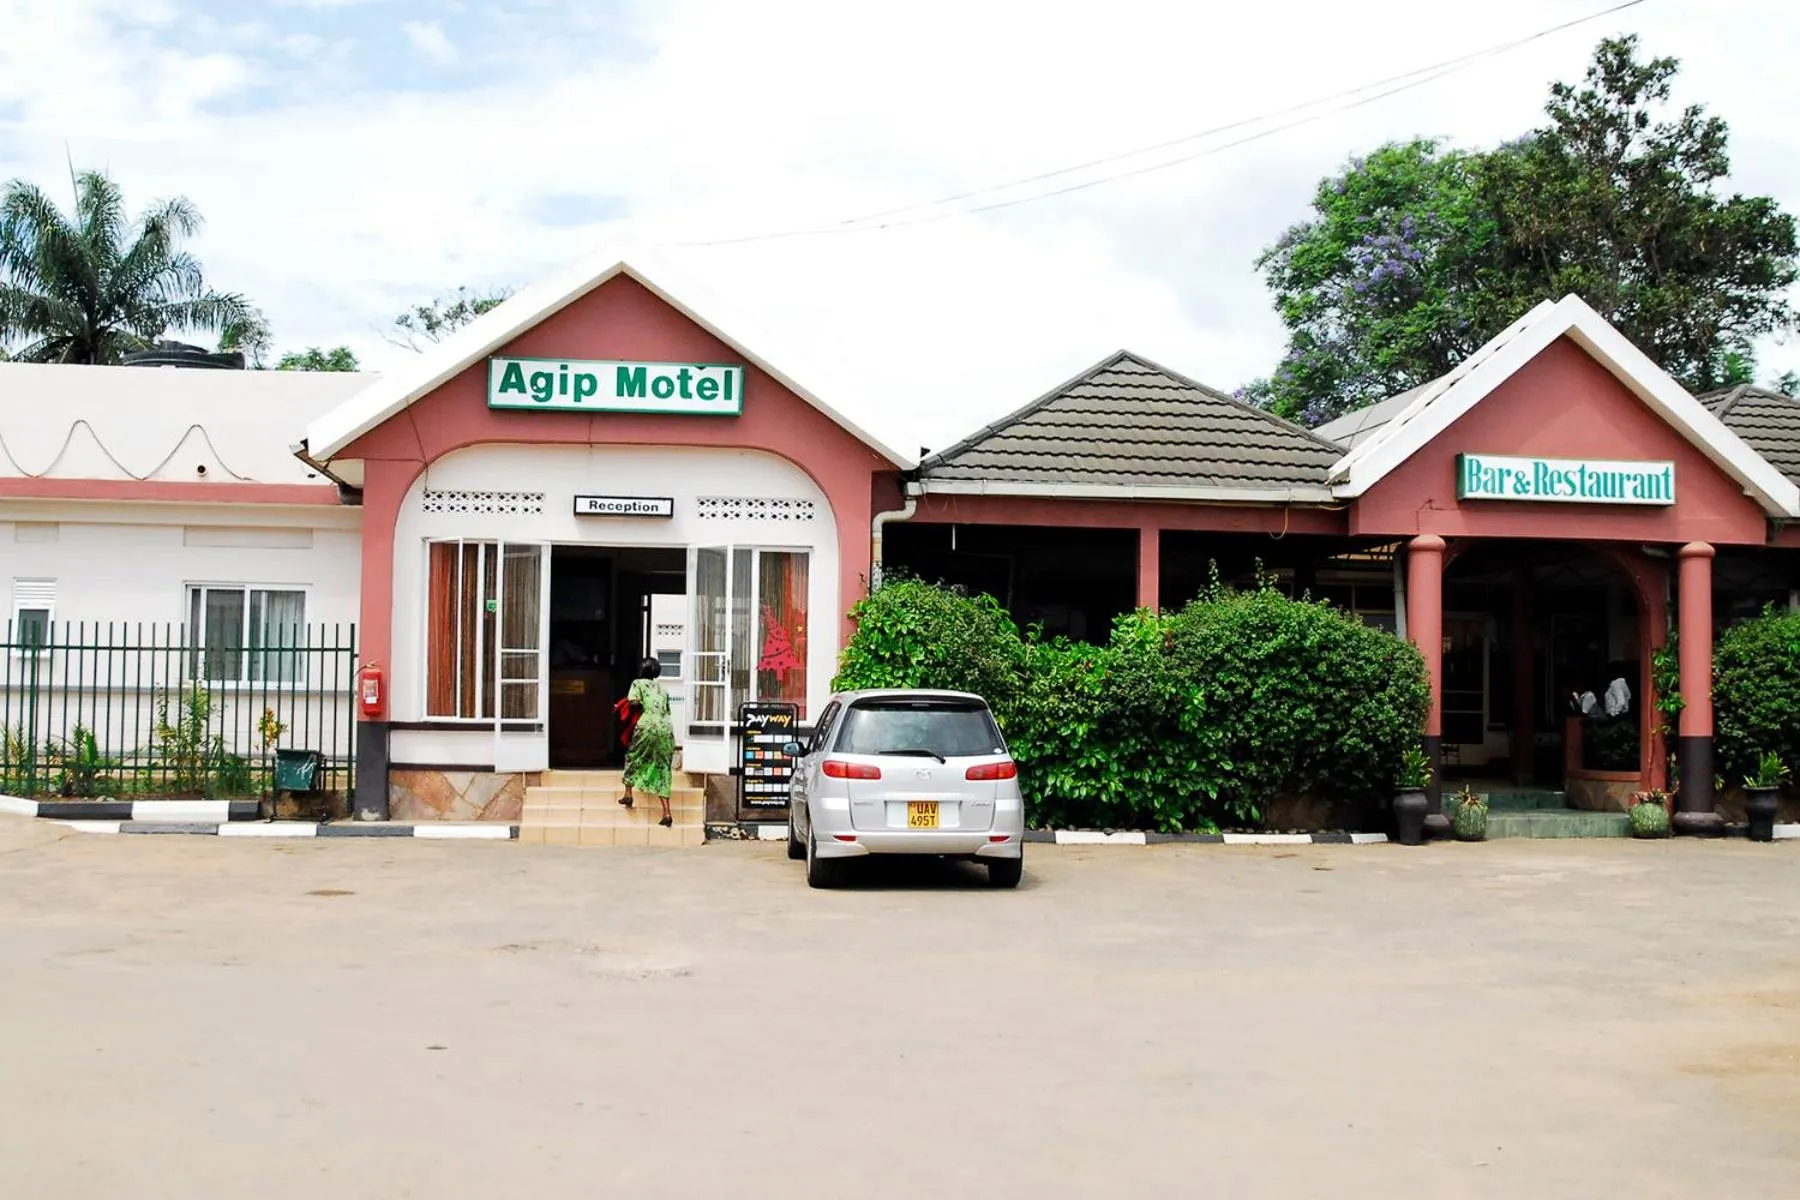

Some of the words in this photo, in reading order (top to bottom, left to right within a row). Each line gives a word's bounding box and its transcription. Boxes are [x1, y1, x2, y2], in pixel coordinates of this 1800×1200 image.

[498, 361, 598, 403] Agip
[615, 366, 733, 401] Motel
[1466, 458, 1673, 500] Bar&Restaurant
[589, 500, 659, 512] Reception
[917, 803, 937, 814] UAV
[910, 815, 936, 826] 495T
